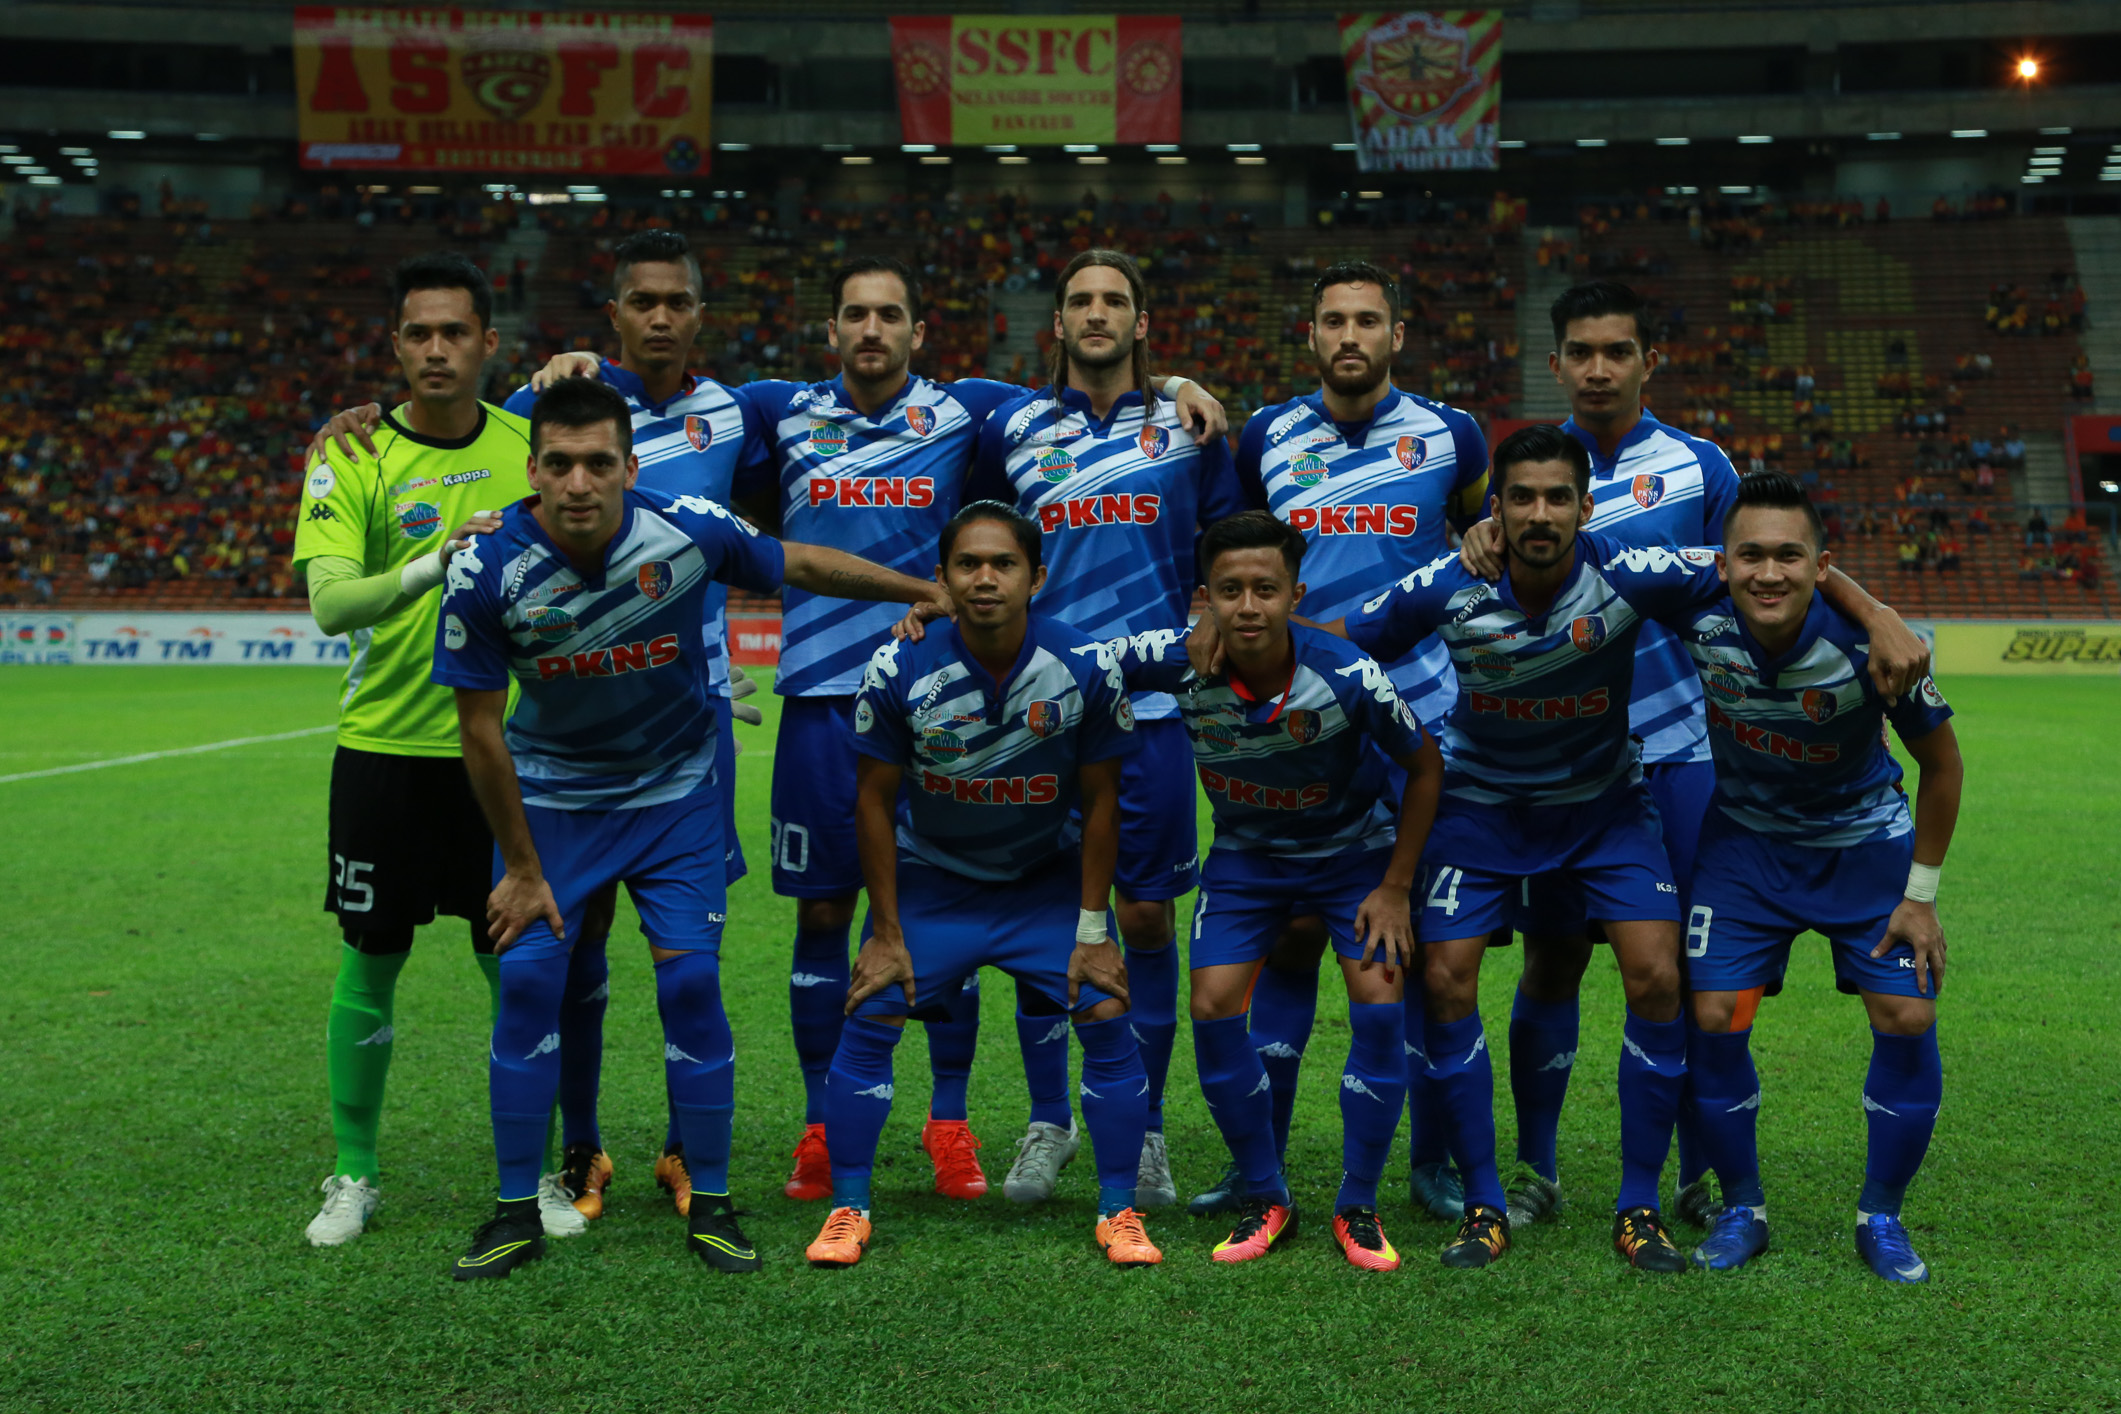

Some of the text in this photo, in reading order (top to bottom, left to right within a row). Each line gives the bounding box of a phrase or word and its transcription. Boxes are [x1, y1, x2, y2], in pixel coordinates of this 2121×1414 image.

[956, 28, 1112, 75] SSFC
[1013, 401, 1040, 443] Kappa
[1271, 404, 1305, 445] Kappa
[1292, 458, 1326, 472] POWER
[1401, 451, 1422, 460] PKNS
[441, 469, 491, 487] Kappa
[808, 476, 935, 508] PKNS
[1637, 489, 1659, 498] PKNS
[1038, 493, 1161, 534] PKNS
[1288, 503, 1418, 536] PKNS
[508, 549, 531, 602] Kappa
[1452, 585, 1488, 629] Kappa
[85, 639, 141, 659] TM
[158, 639, 214, 659] TM
[238, 639, 295, 659] TM
[537, 633, 681, 681] PKNS
[913, 671, 949, 719] Kappa
[1470, 687, 1610, 721] PKNS
[953, 714, 982, 722] PKNS
[1708, 700, 1840, 763] PKNS
[923, 769, 1059, 804] PKNS
[1197, 763, 1330, 810] PKNS
